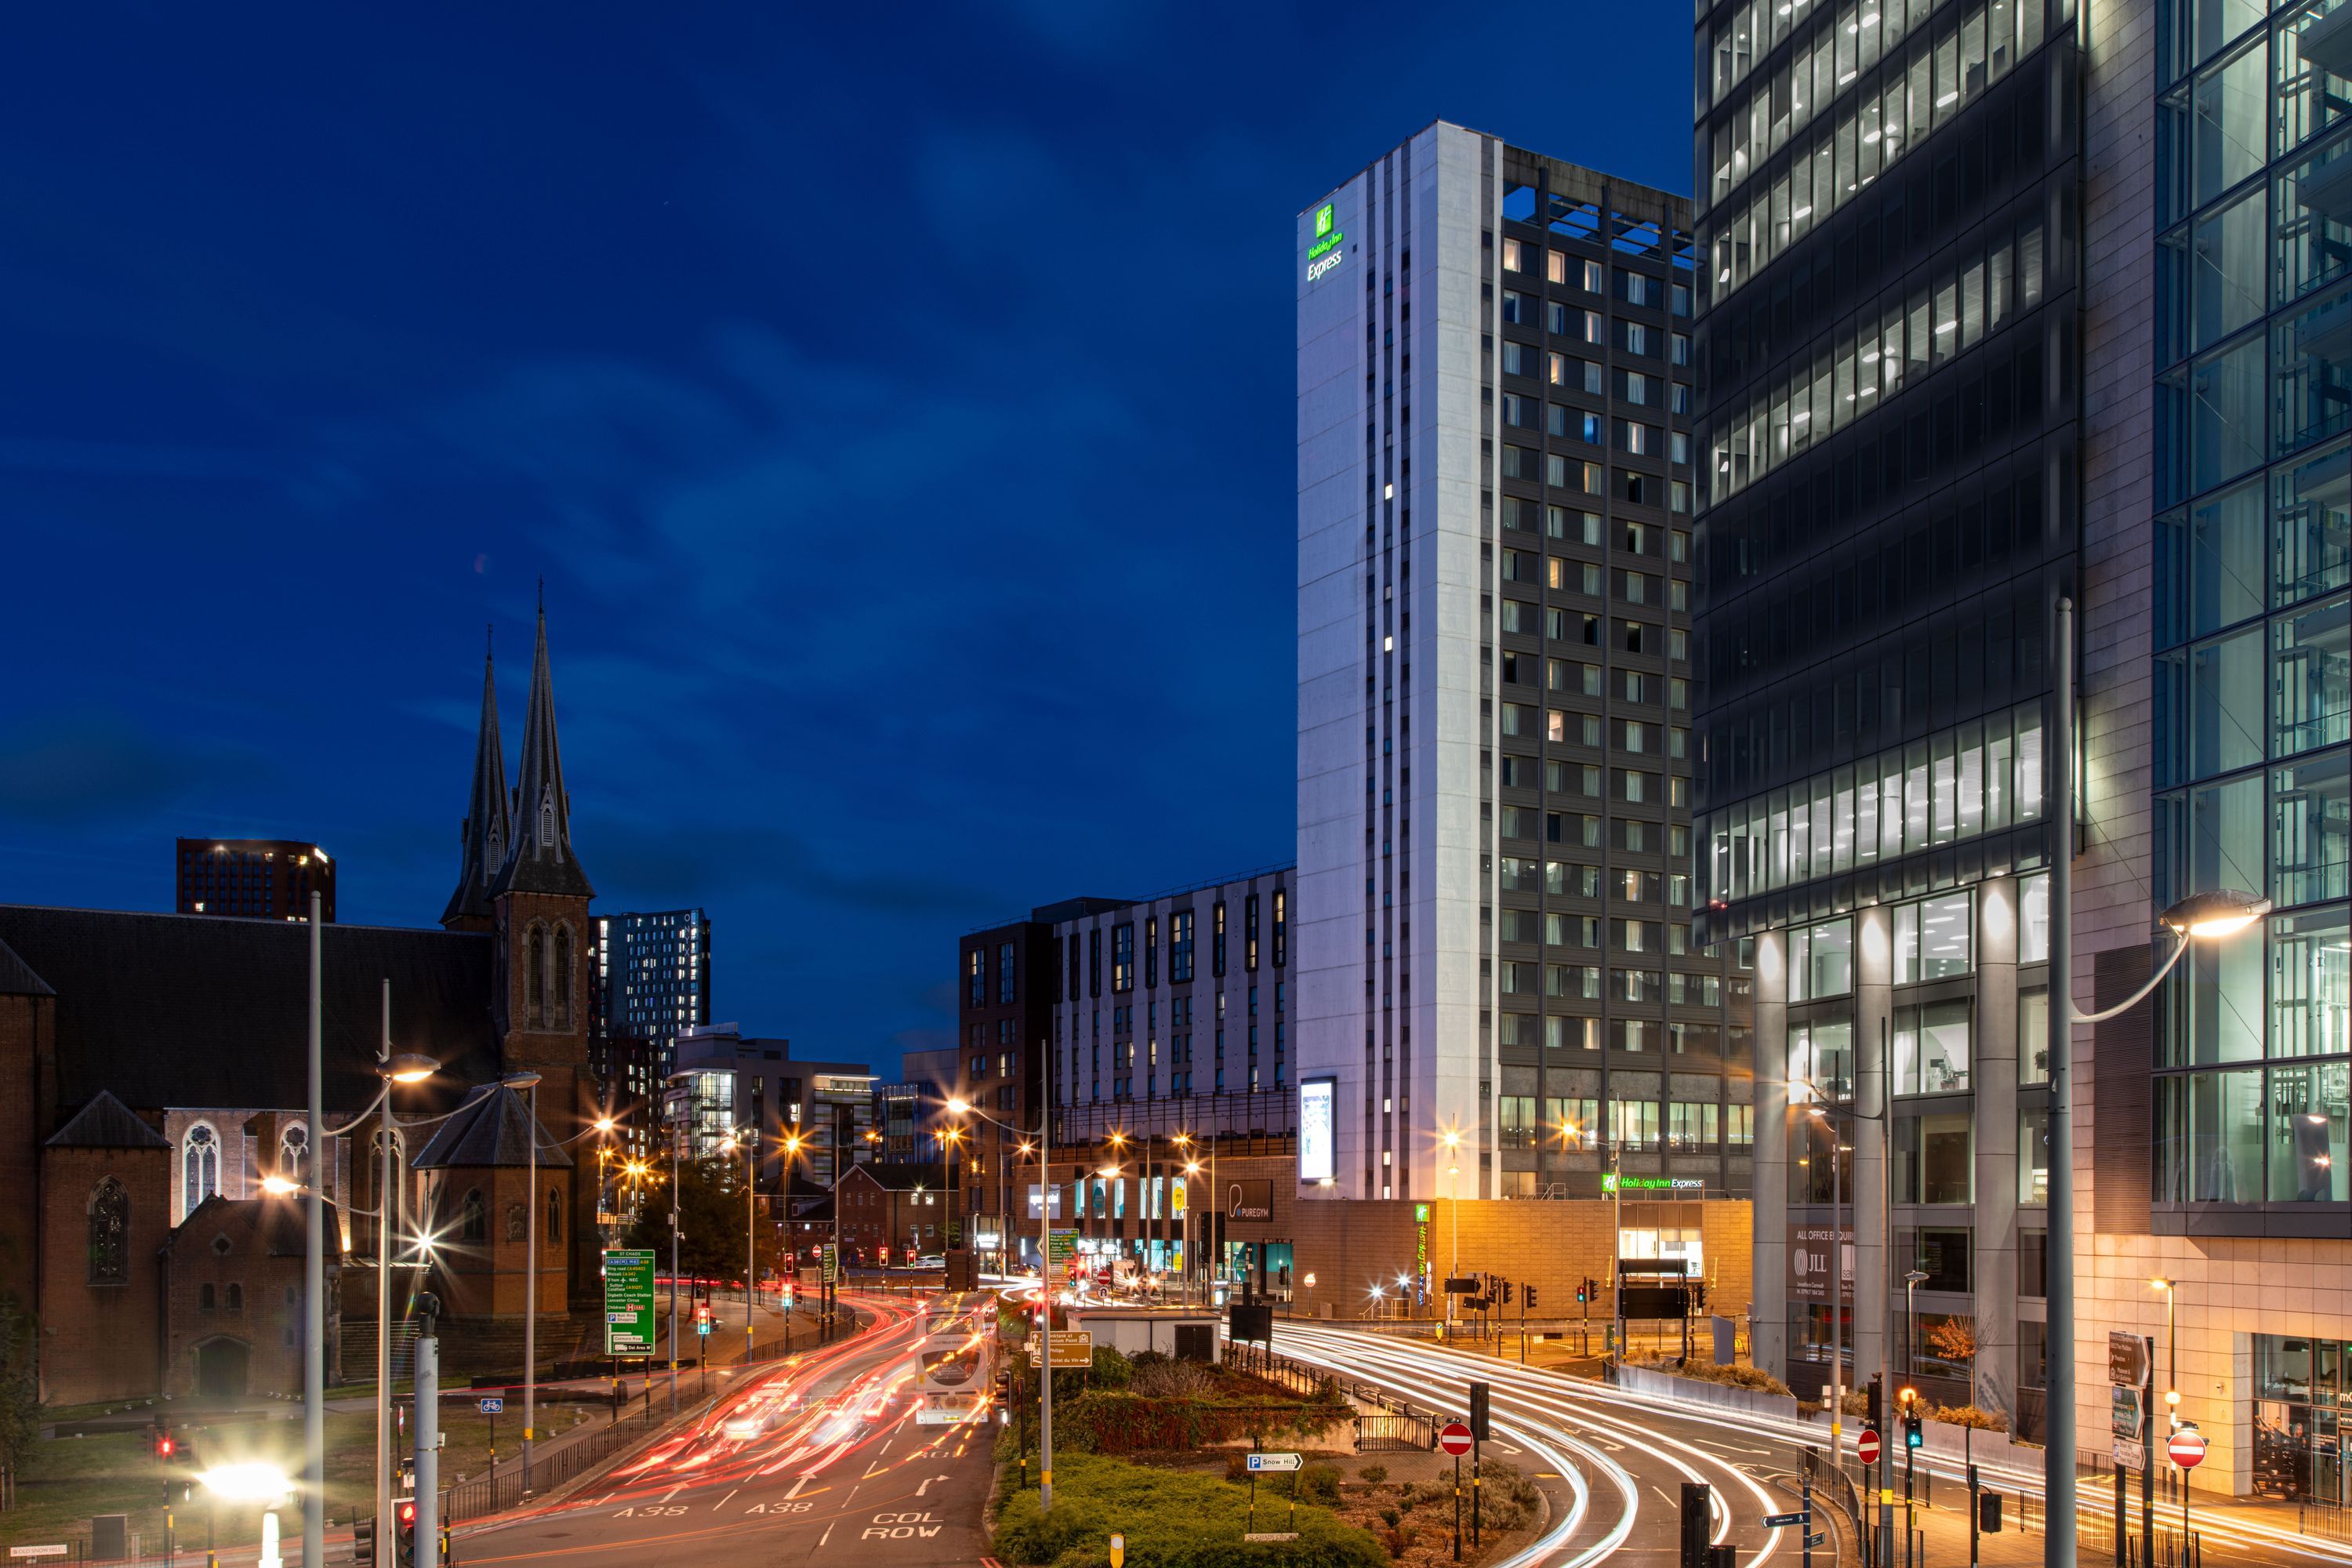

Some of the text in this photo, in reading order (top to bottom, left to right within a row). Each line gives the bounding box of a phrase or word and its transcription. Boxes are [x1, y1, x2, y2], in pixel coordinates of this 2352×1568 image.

[1308, 233, 1343, 260] Holiday Inn
[1308, 250, 1342, 281] Express
[1621, 1178, 1702, 1189] Holiday Inn Express
[1242, 1208, 1269, 1218] PUREGYM
[1797, 1230, 1807, 1240] ALL
[1808, 1230, 1828, 1240] OFFICE
[1417, 1225, 1426, 1260] Holiday
[1808, 1254, 1828, 1272] JLL
[612, 1505, 690, 1519] A38
[744, 1501, 814, 1514] A38
[871, 1512, 946, 1524] COL
[860, 1525, 943, 1541] ROW
